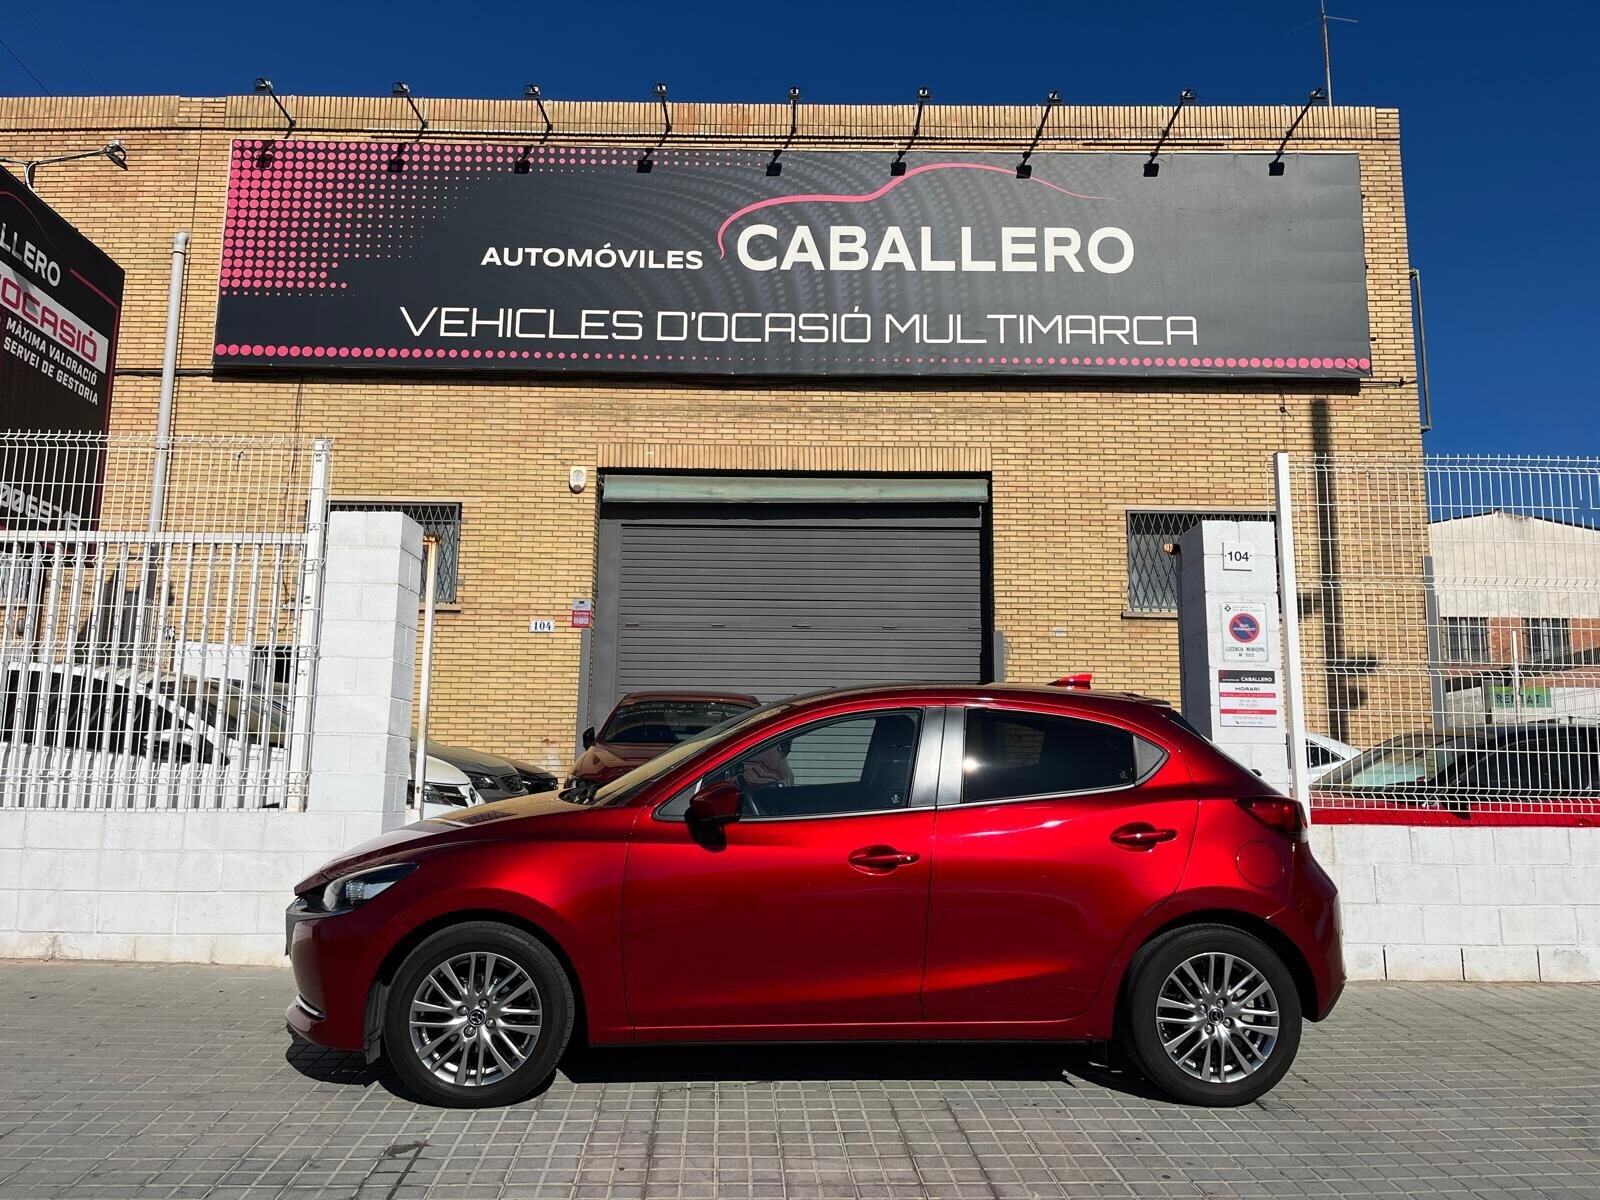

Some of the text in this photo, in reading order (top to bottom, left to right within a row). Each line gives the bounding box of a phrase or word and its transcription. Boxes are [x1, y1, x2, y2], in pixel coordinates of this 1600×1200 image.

[480, 223, 1136, 275] AUTOMÓVILES CABALLERO
[399, 305, 1198, 346] VEHICLES D'OCASIÓ MULTIMARCA
[3, 336, 98, 406] SERVEI DE GESTORIA
[6, 317, 98, 386] MÀXIMA VALORACIÓ
[1227, 551, 1250, 562] 104
[534, 621, 552, 631] 104
